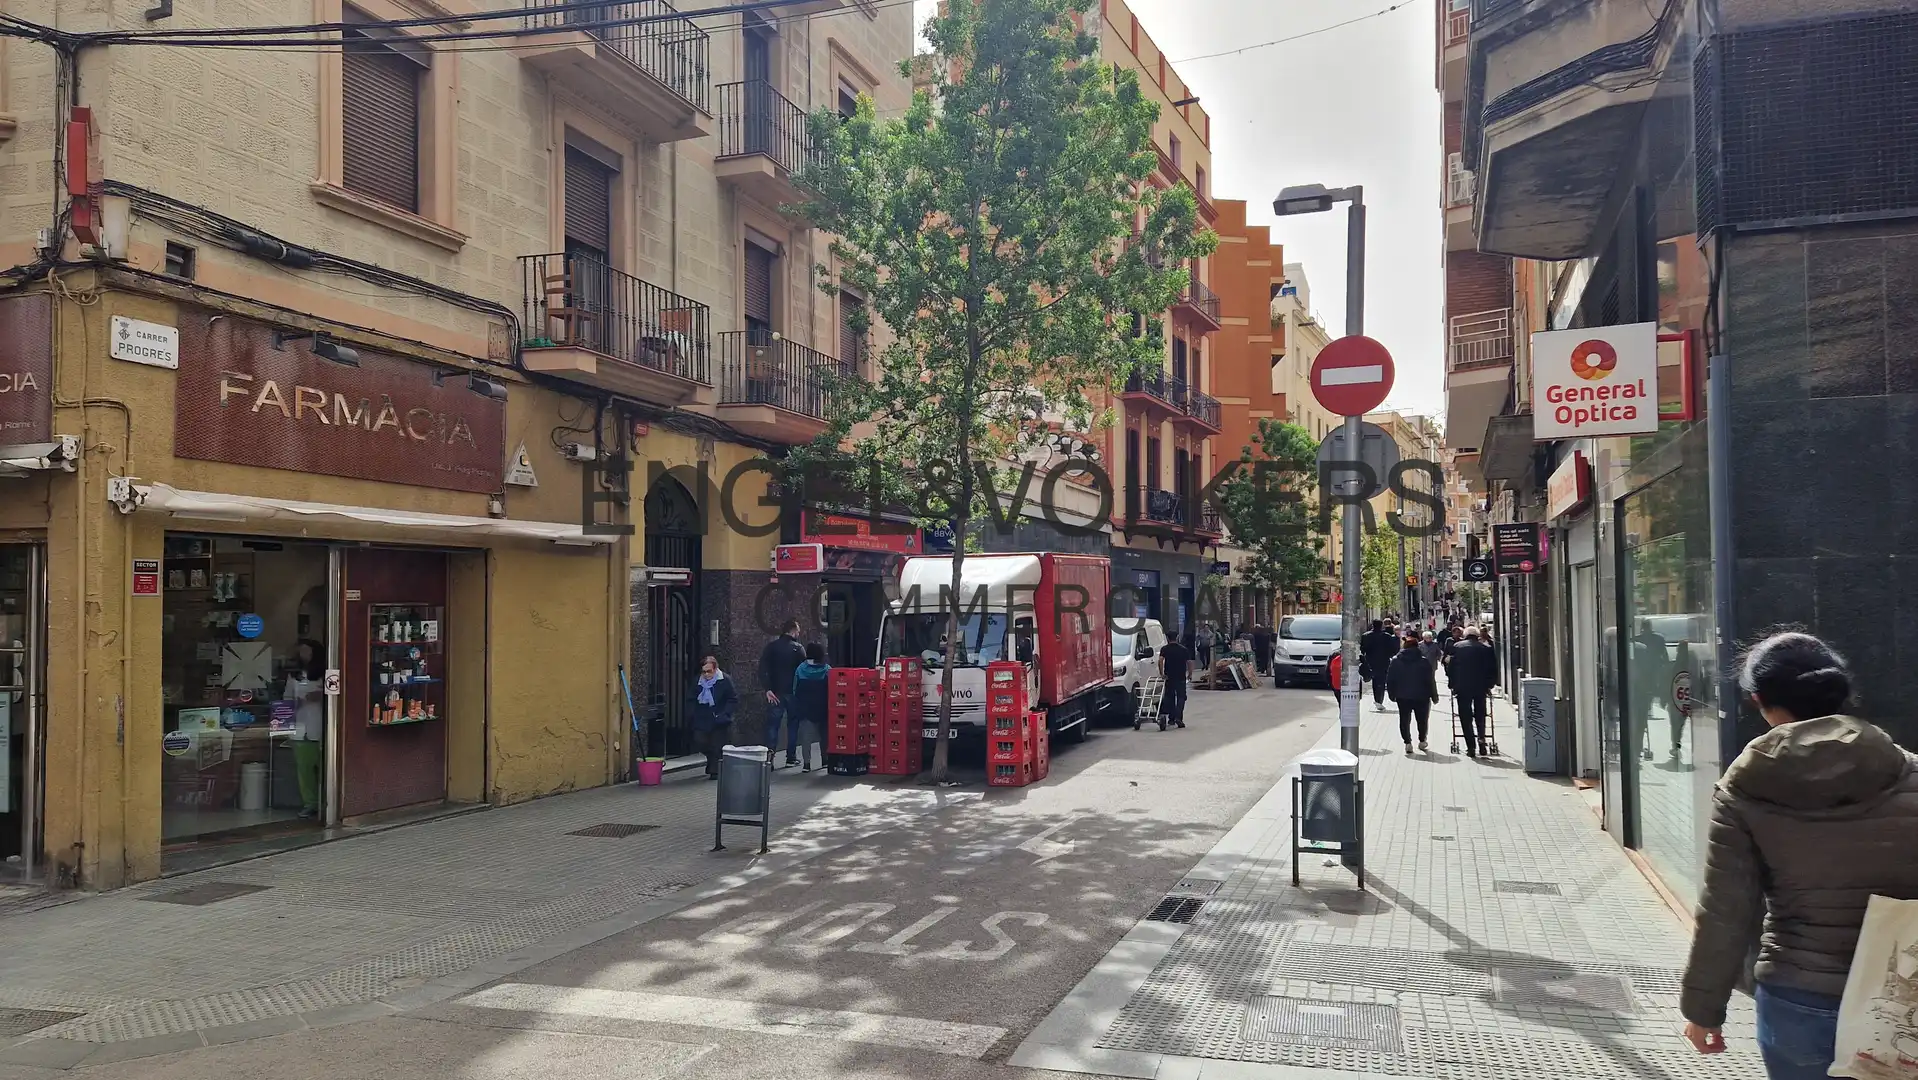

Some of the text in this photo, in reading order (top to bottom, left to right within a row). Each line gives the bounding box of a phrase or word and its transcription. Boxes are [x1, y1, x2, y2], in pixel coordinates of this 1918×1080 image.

[136, 330, 168, 344] CARRER
[1546, 378, 1647, 404] General
[1555, 402, 1637, 428] Optica
